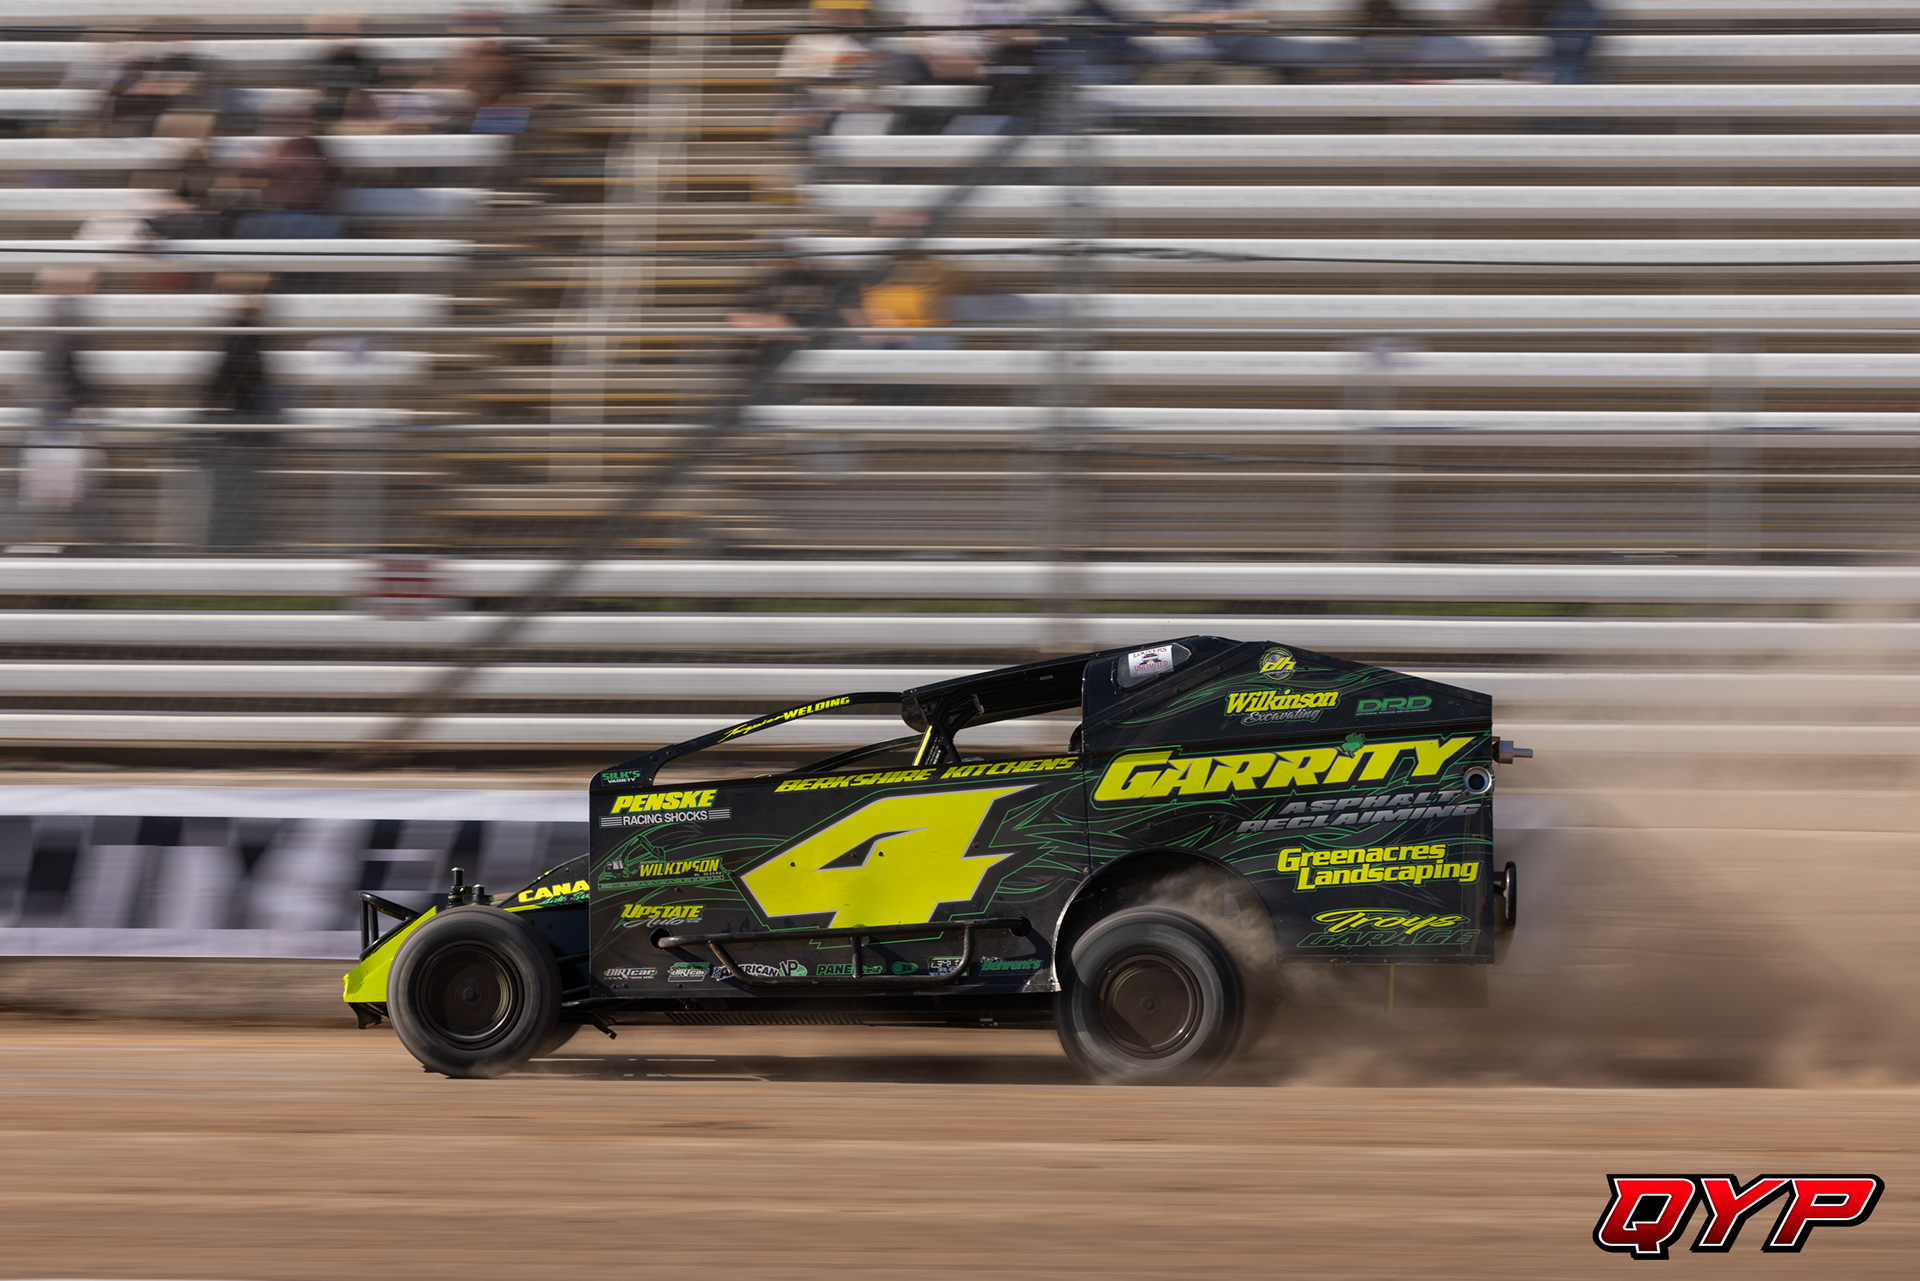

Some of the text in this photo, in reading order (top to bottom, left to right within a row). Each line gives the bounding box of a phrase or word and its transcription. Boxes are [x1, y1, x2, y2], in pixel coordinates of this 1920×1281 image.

[1134, 660, 1169, 671] UNLIMITED
[783, 696, 850, 720] WELDING
[1226, 689, 1339, 714] Wilkinson
[1357, 696, 1432, 713] DRD
[1243, 708, 1322, 725] Excavating
[602, 769, 641, 781] SILK'S
[774, 756, 1080, 793] BERKSHIRE KITCHENS
[1093, 736, 1476, 801] GARRITY
[611, 789, 718, 814] PENSKE
[1278, 790, 1462, 815] ASPHALT
[623, 810, 708, 826] RACING SHOCKS
[1235, 803, 1483, 834] RECLAIMING
[740, 783, 1039, 927] 4
[1276, 844, 1446, 872] Greenacres
[639, 858, 721, 877] WILKINSON
[1296, 859, 1480, 890] Landscaping
[620, 903, 704, 918] UPSTATE
[622, 915, 685, 928] Auto
[1315, 909, 1465, 935] Troys
[1296, 929, 1481, 947] GARAGE
[982, 960, 1042, 971] Behrent's
